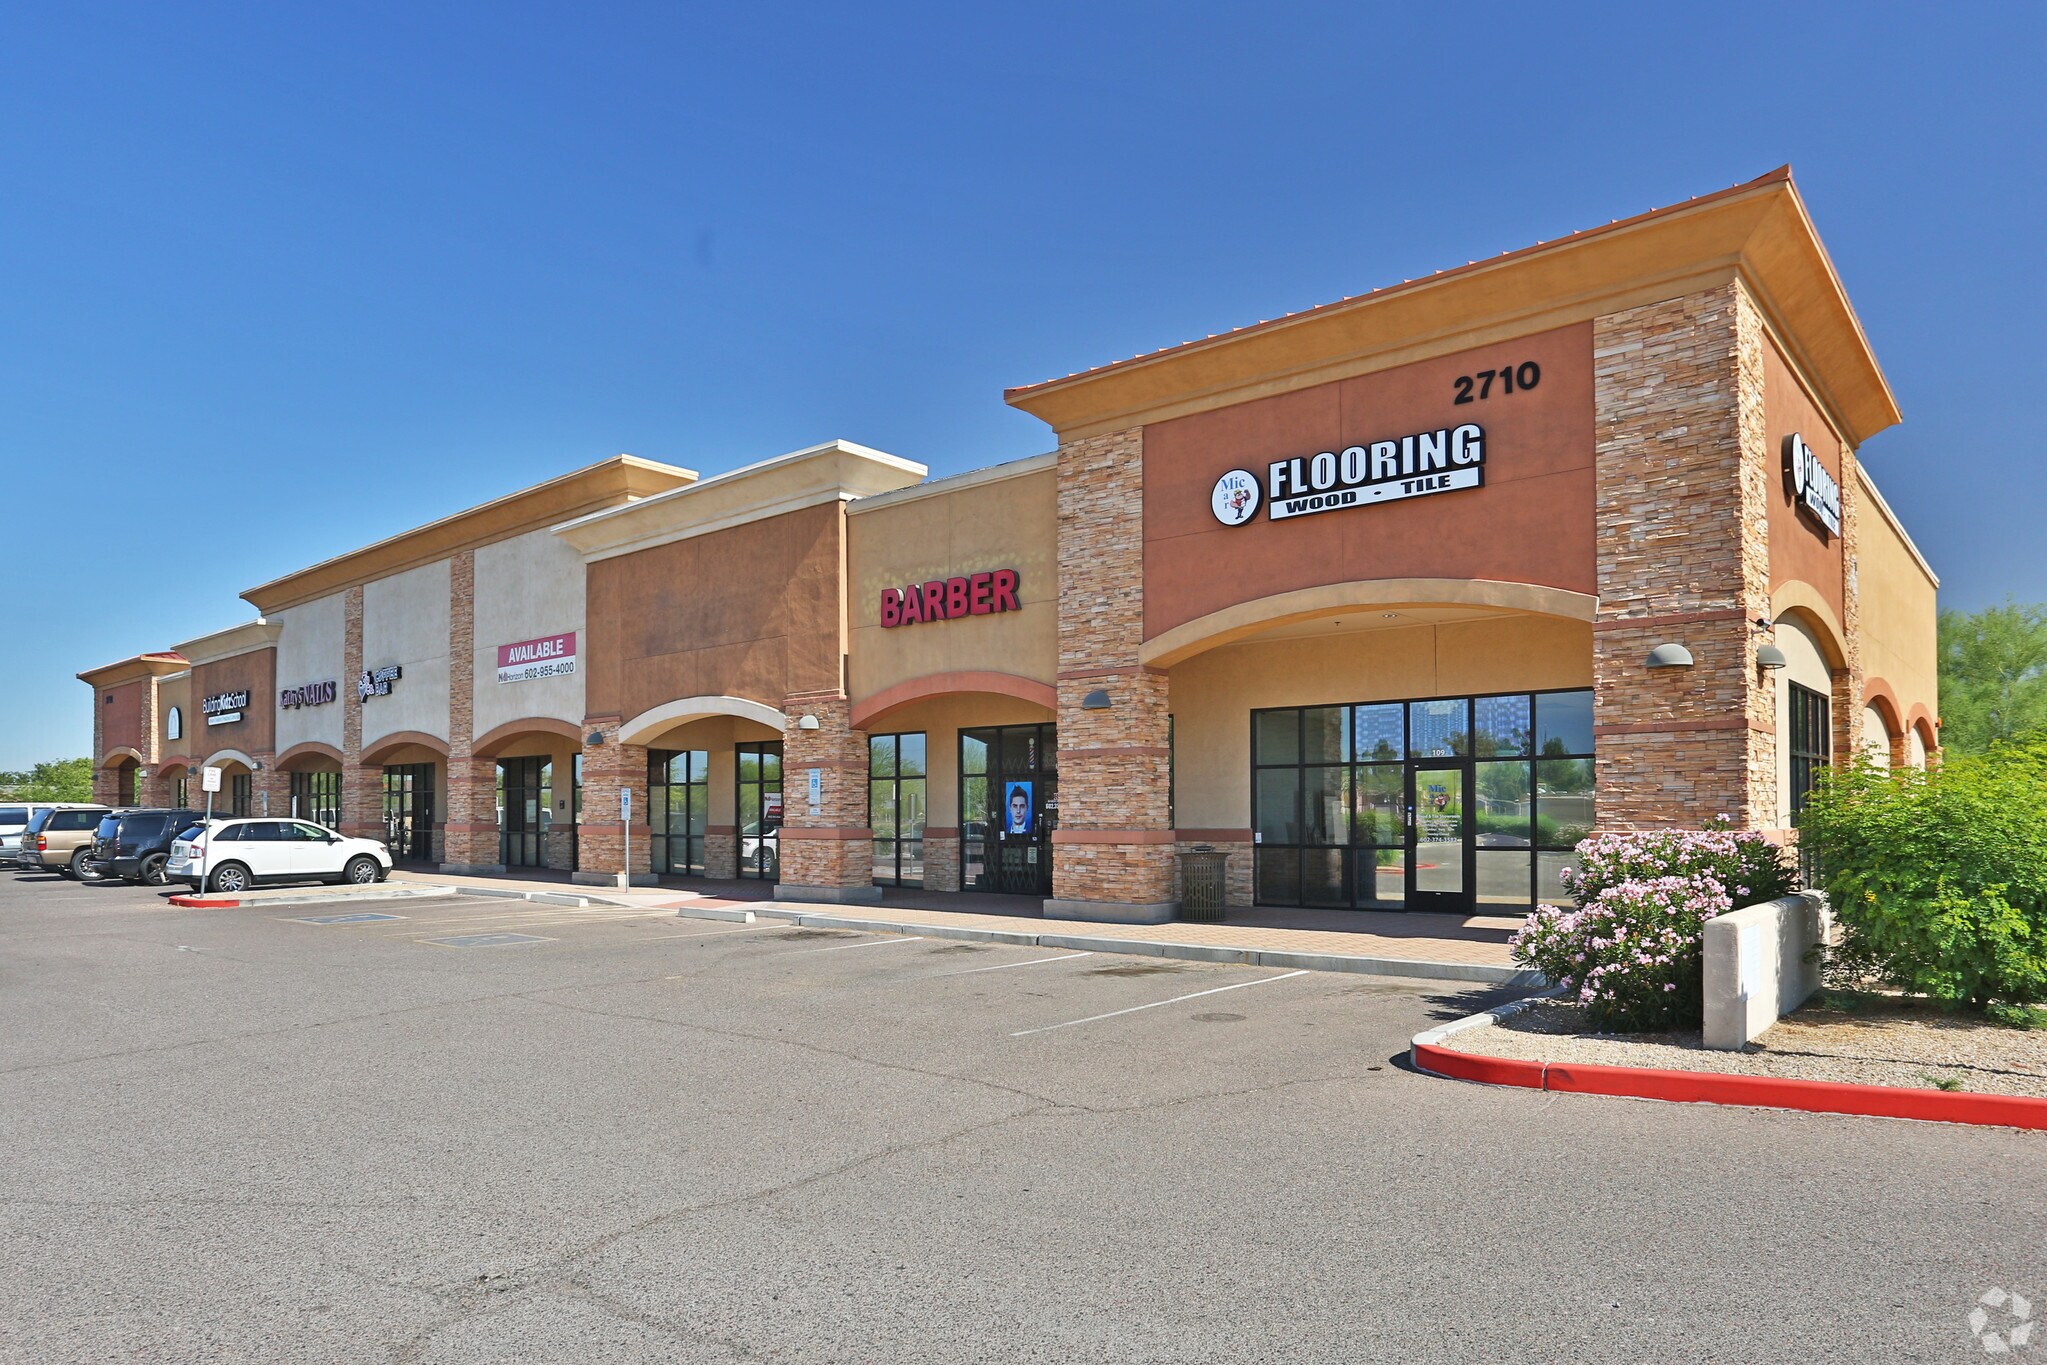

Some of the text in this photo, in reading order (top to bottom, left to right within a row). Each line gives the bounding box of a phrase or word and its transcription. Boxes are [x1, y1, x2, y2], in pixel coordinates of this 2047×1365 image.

[1454, 361, 1541, 405] 2710
[1268, 423, 1485, 501] FLOORING
[1221, 477, 1246, 491] Mic
[1285, 474, 1451, 514] WOOD TILE
[881, 569, 1022, 628] BARBER
[508, 638, 564, 663] AVAILABLE
[375, 665, 402, 682] COFFEE
[525, 662, 574, 679] 602-955-4000
[304, 680, 336, 706] NAILS
[375, 682, 391, 696] BAR
